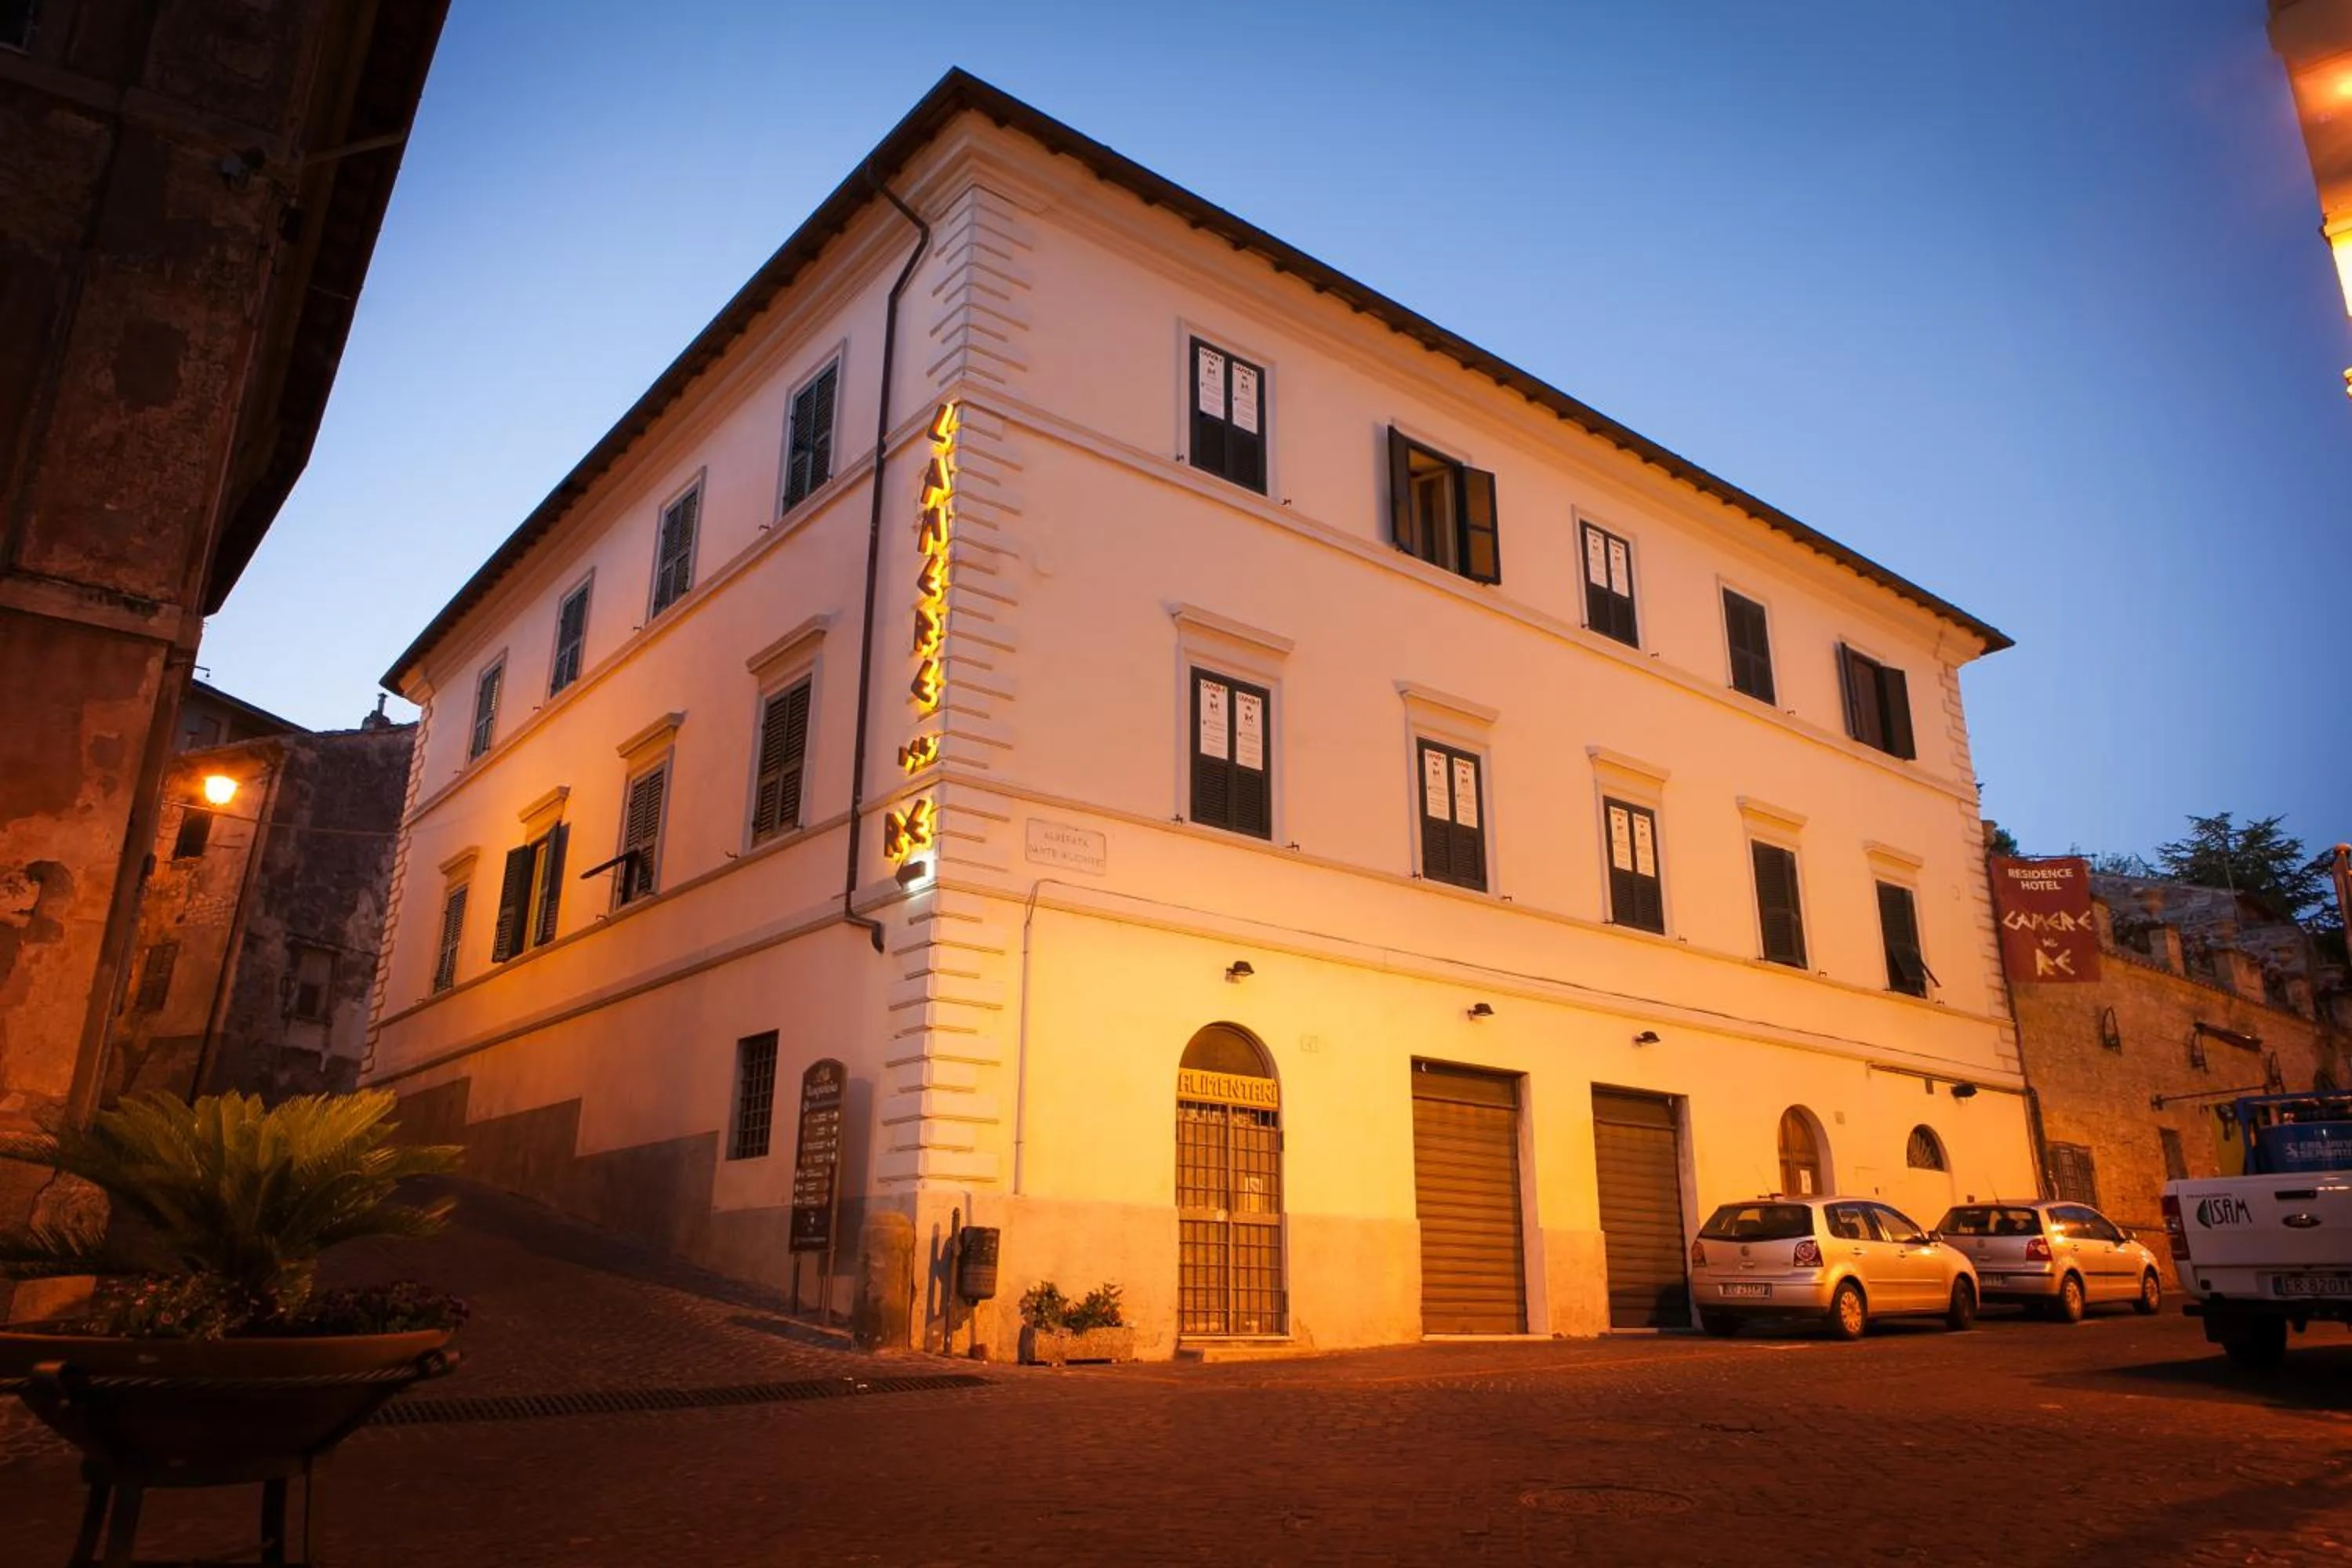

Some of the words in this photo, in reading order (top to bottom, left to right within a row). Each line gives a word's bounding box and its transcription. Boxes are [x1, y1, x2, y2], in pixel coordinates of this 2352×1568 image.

[2007, 867, 2074, 879] RESIDENCE
[2020, 880, 2062, 891] HOTEL
[2002, 910, 2092, 931] CAMERE
[2035, 949, 2075, 976] RE
[1178, 1072, 1277, 1103] ALIMENTARI
